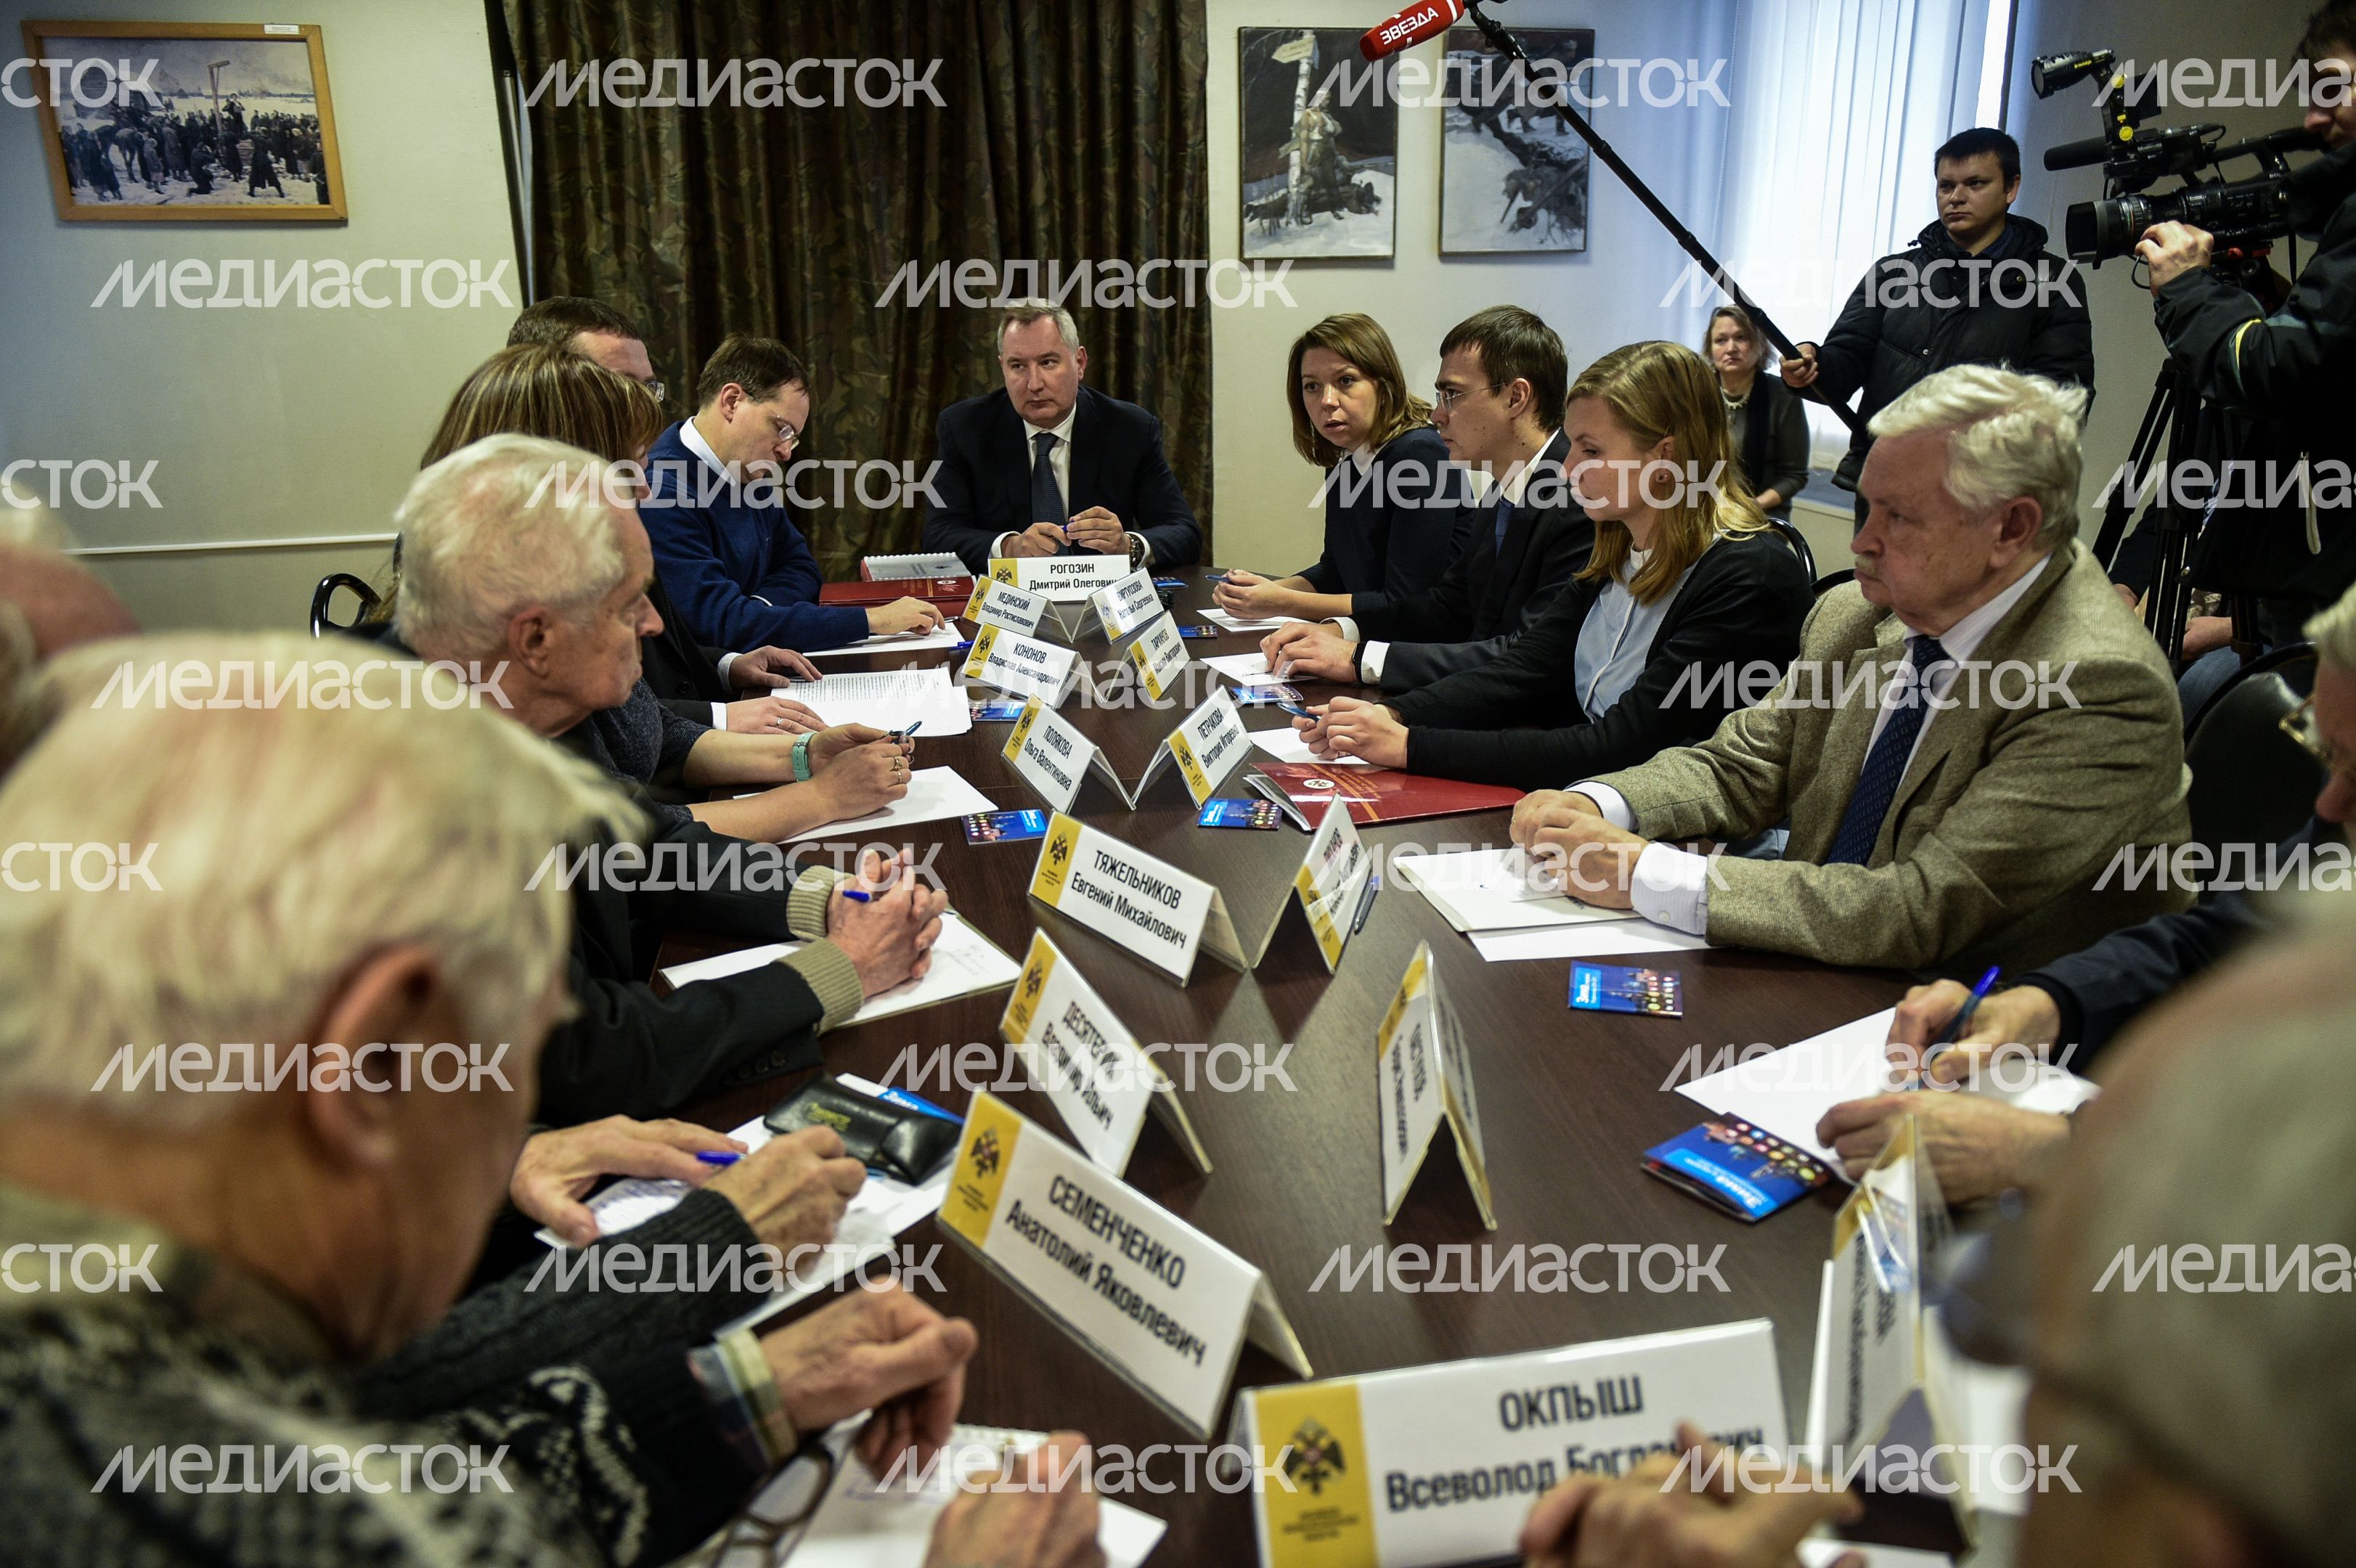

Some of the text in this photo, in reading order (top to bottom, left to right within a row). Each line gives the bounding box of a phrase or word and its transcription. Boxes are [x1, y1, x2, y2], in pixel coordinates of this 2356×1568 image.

[1379, 7, 1438, 45] ЗВЕЗДА
[1030, 579, 1071, 592] Дмитрий
[1050, 563, 1095, 574] РОГОЗИН
[981, 601, 1003, 618] Владимир
[1002, 608, 1035, 629] Ростиславович
[998, 591, 1031, 612] МЕДИНСКИЙ
[987, 652, 1016, 672] Владислав
[1016, 662, 1060, 687] Александрович
[1014, 642, 1047, 664] КОНОНОВ
[1197, 707, 1225, 740] ПЕТРАКОВА
[1043, 724, 1072, 759] ПОЛЯКОВА
[1201, 735, 1223, 769] Виктория
[1024, 737, 1072, 791] Ольга Валентиновна
[1094, 849, 1182, 910] ТЯЖЕЛЬНИКОВ
[1070, 872, 1188, 950] Евгений Михайлович
[1048, 1173, 1186, 1291] СЕМЕНЧЕНКО
[1006, 1199, 1206, 1367] Анатолий Яковлевич
[1499, 1374, 1644, 1432] ОКПЫШ
[1386, 1453, 1557, 1514] Всеволод
